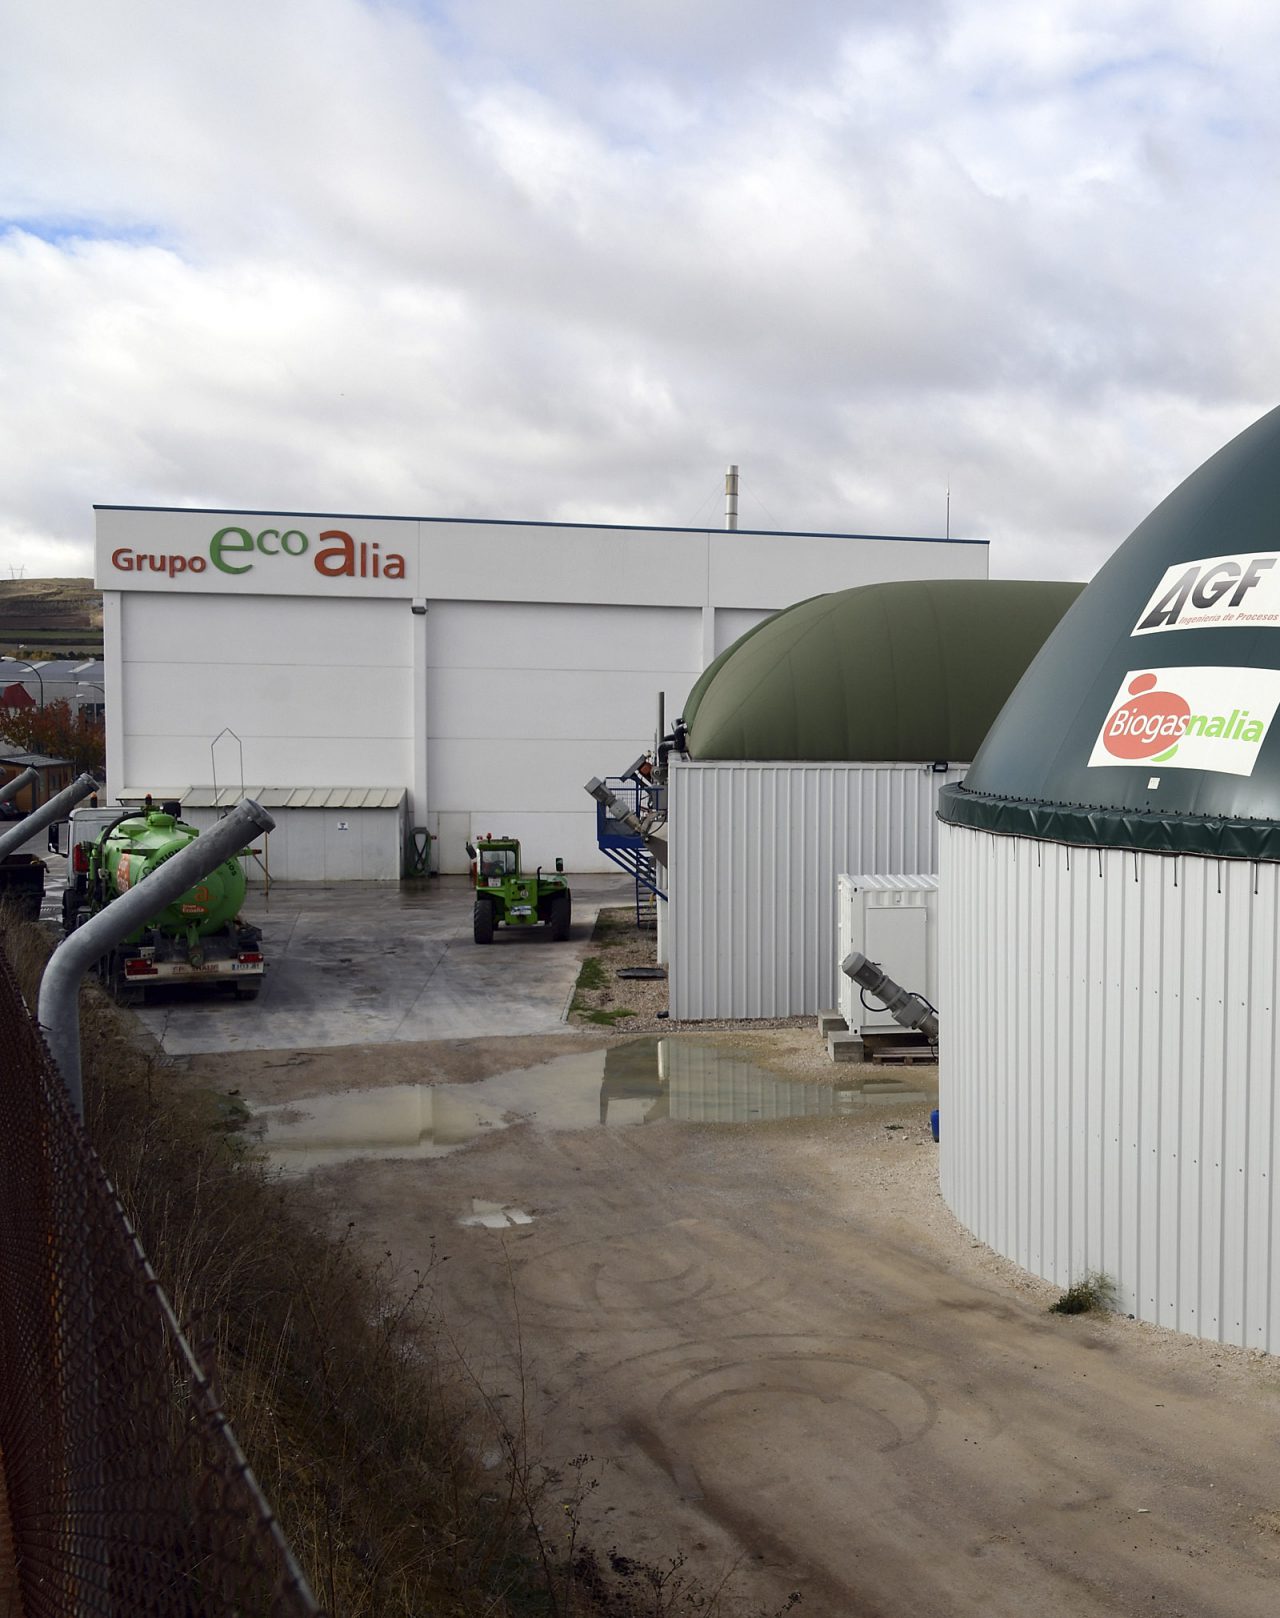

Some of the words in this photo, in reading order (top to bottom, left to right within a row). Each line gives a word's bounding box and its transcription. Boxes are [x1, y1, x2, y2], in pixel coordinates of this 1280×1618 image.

[111, 548, 207, 578] Grupo
[1137, 558, 1278, 630] AGF
[1222, 612, 1235, 622] de
[1235, 611, 1280, 622] Procesos
[1108, 708, 1265, 744] Biogasnalia
